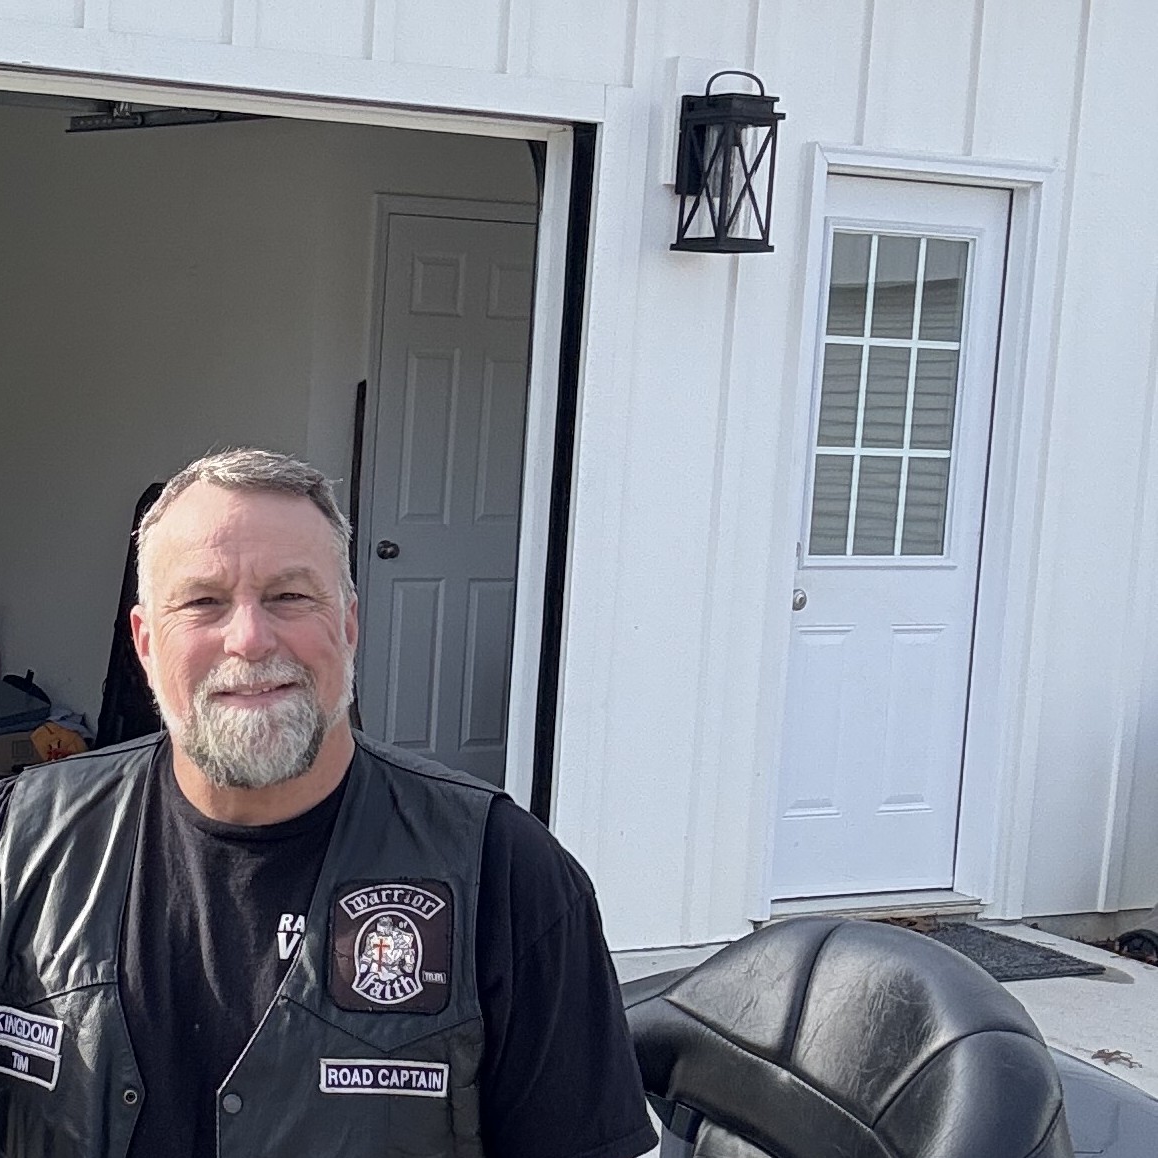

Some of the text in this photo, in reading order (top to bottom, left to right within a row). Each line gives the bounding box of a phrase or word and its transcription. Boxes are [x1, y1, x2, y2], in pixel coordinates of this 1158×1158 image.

[11, 1051, 29, 1073] TIM
[327, 1068, 442, 1090] ROAD CAPTAIN
